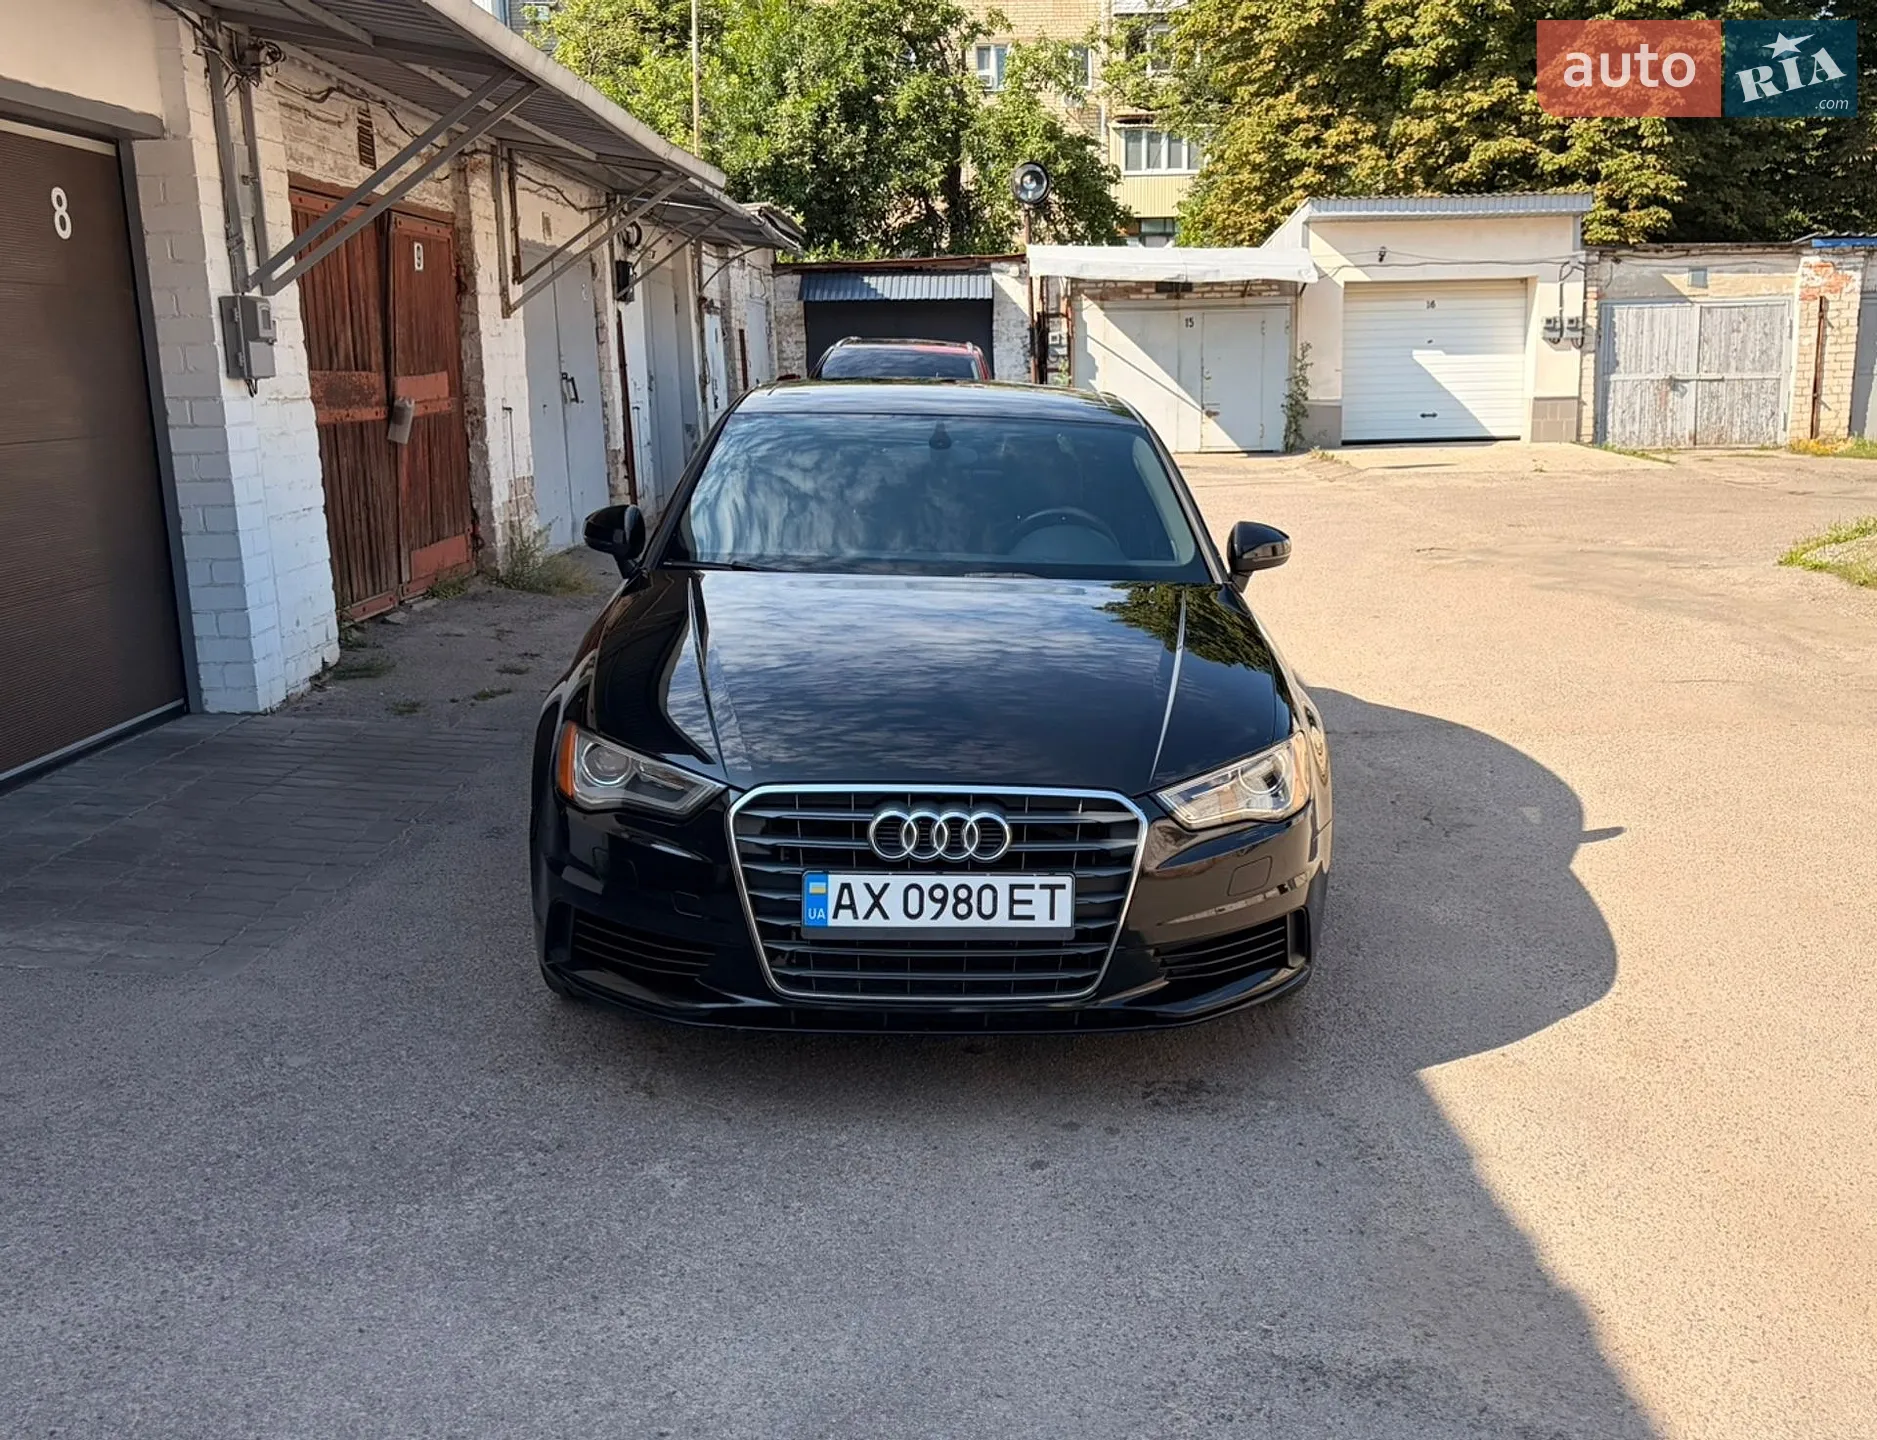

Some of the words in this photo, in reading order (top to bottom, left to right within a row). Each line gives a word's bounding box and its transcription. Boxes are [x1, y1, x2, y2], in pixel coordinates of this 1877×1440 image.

[51, 186, 72, 240] 8
[1184, 316, 1195, 329] 15
[807, 907, 826, 920] UA
[832, 882, 891, 920] AX
[902, 882, 999, 921] 0980
[1008, 883, 1067, 921] ET
